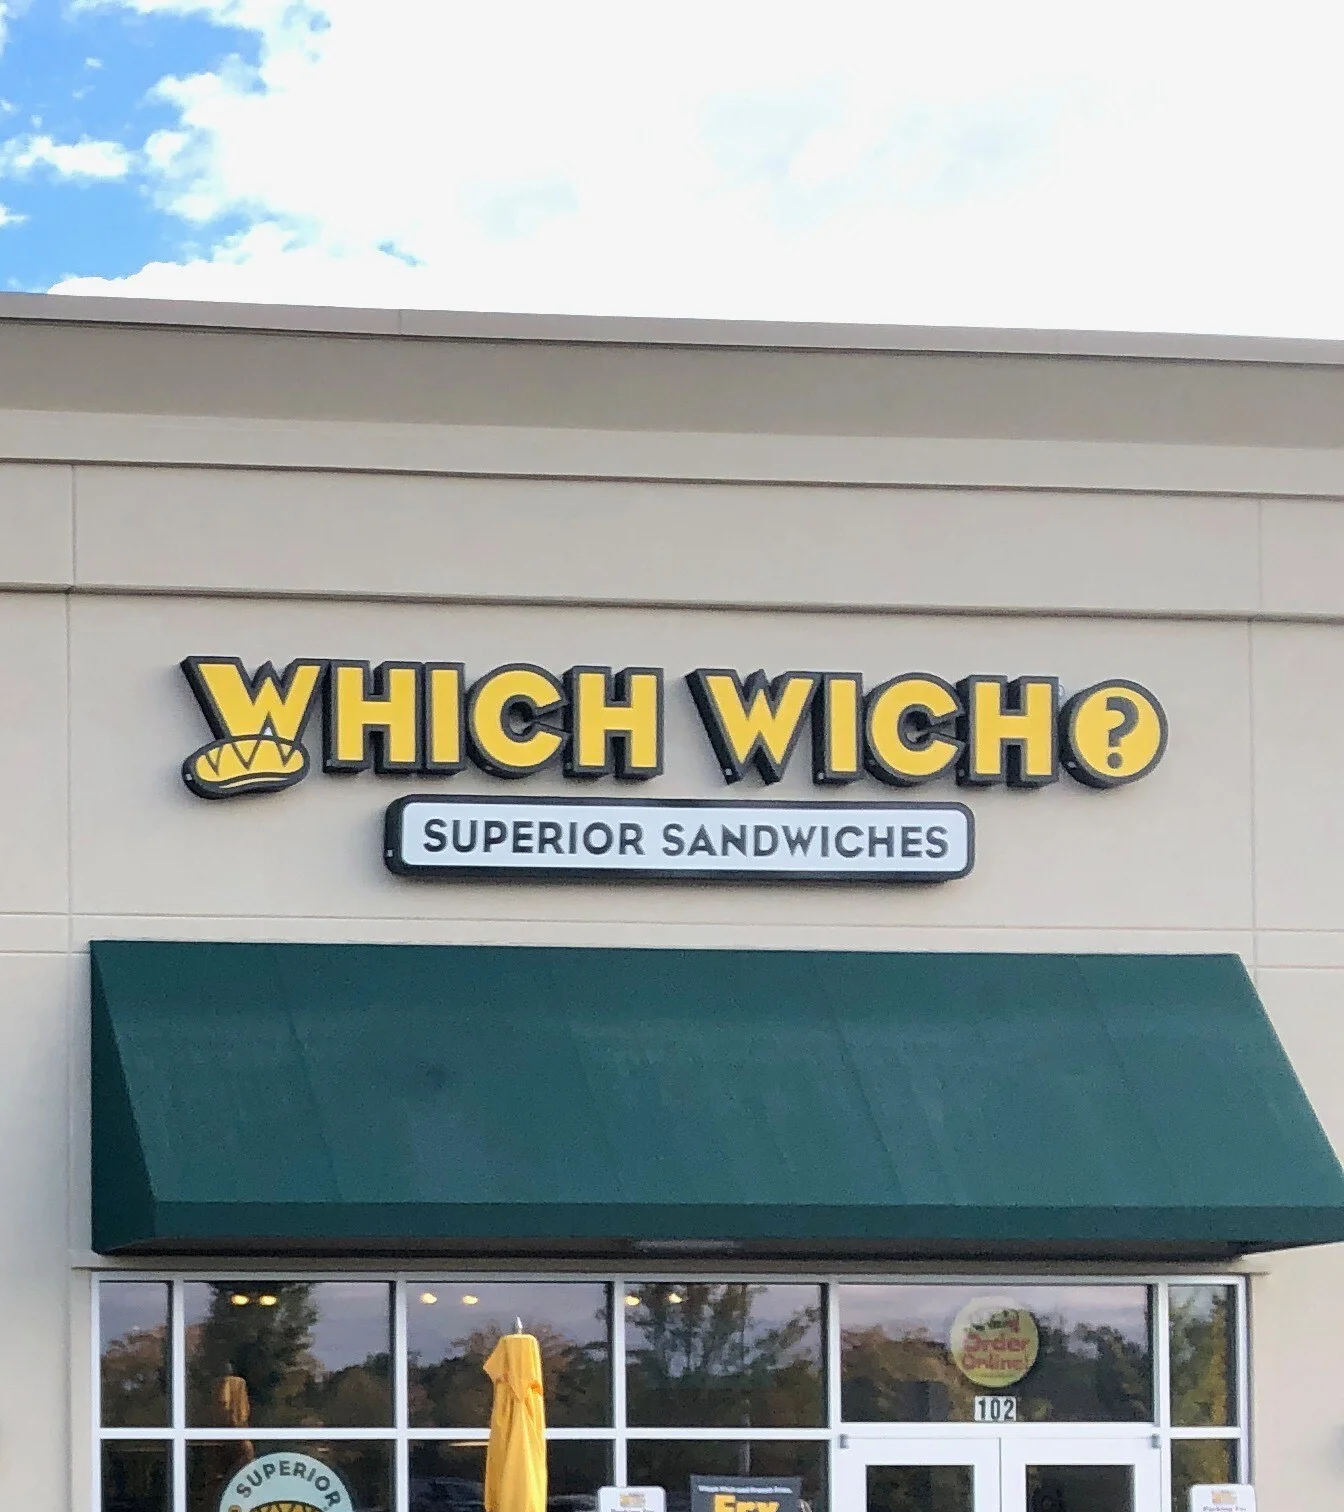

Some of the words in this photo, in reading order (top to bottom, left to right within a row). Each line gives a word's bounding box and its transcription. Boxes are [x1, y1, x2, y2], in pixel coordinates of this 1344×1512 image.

[181, 656, 663, 780] WHICH
[423, 818, 644, 856] SUPERIOR
[661, 823, 949, 859] SANDWICHES
[978, 1399, 1014, 1420] 102
[236, 1460, 340, 1511] SUPERIOR
